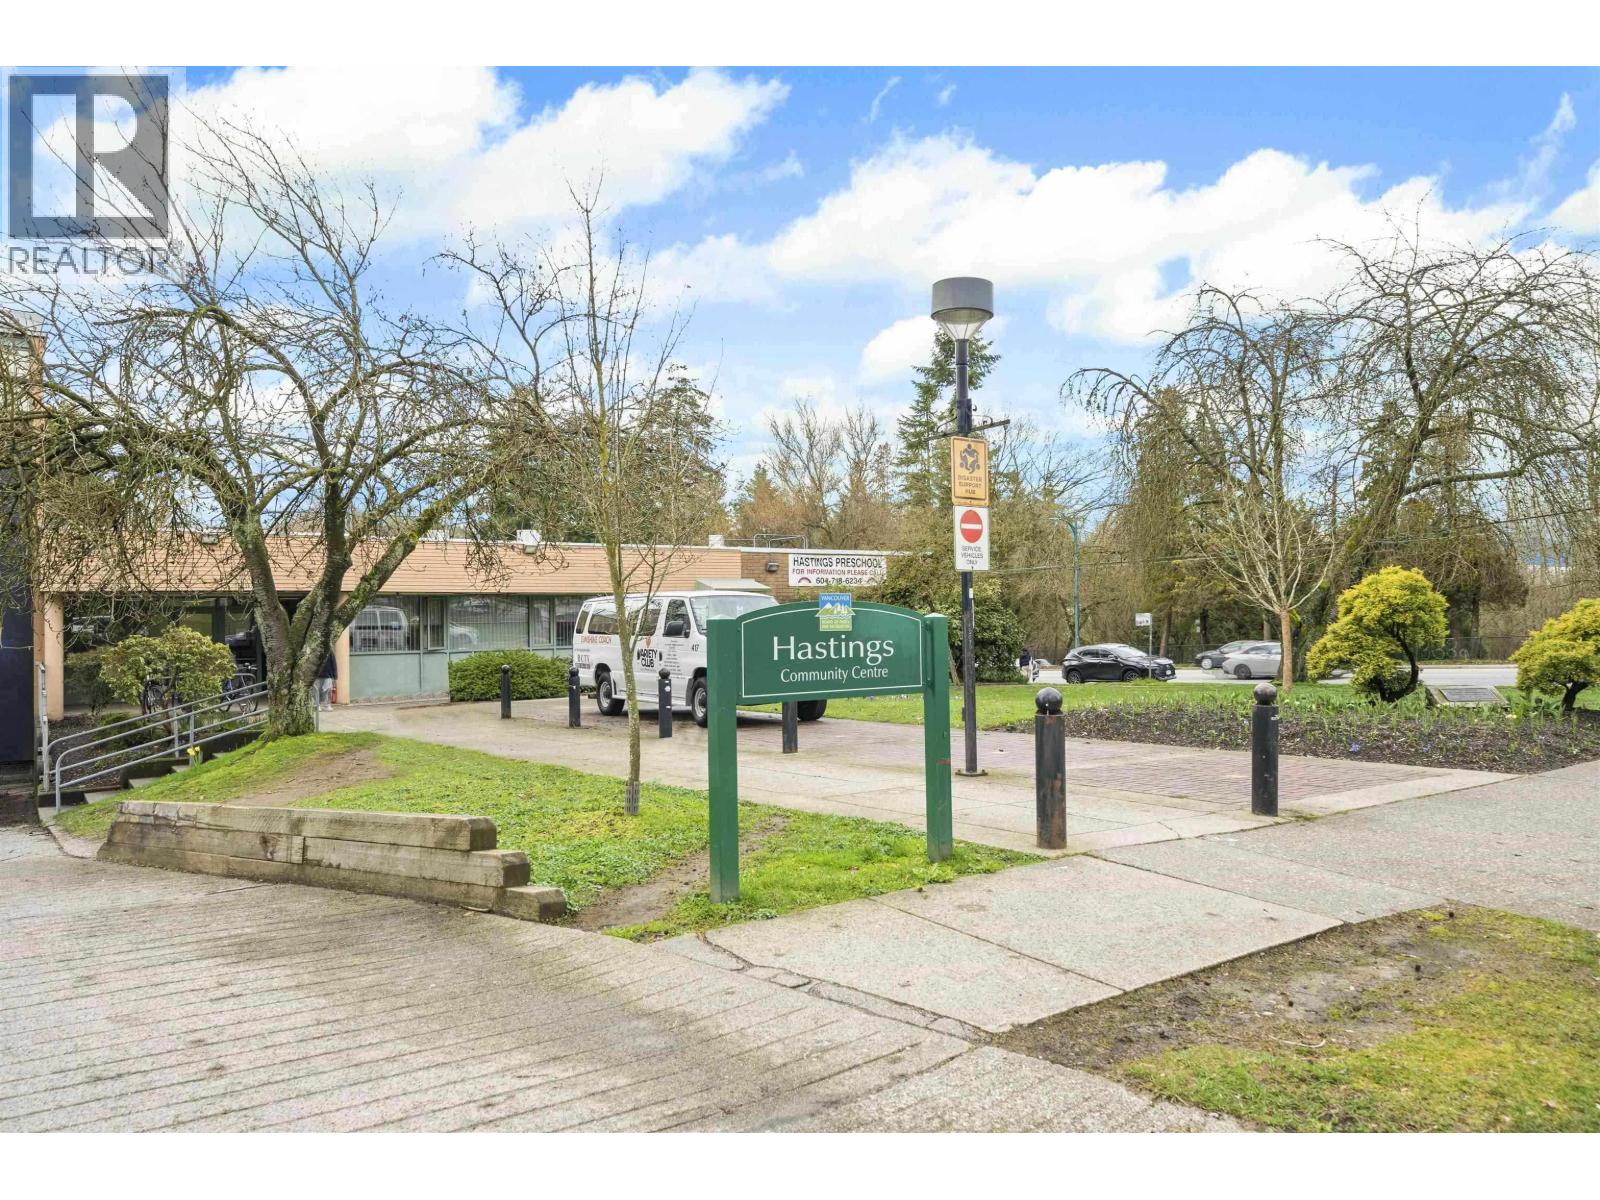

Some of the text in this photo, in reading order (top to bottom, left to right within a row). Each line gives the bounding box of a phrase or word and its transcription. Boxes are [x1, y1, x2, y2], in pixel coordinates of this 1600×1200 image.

[793, 556, 882, 568] HASTINGS PRESCHOOL
[773, 634, 895, 666] Hastings
[780, 665, 889, 684] Community Centre
